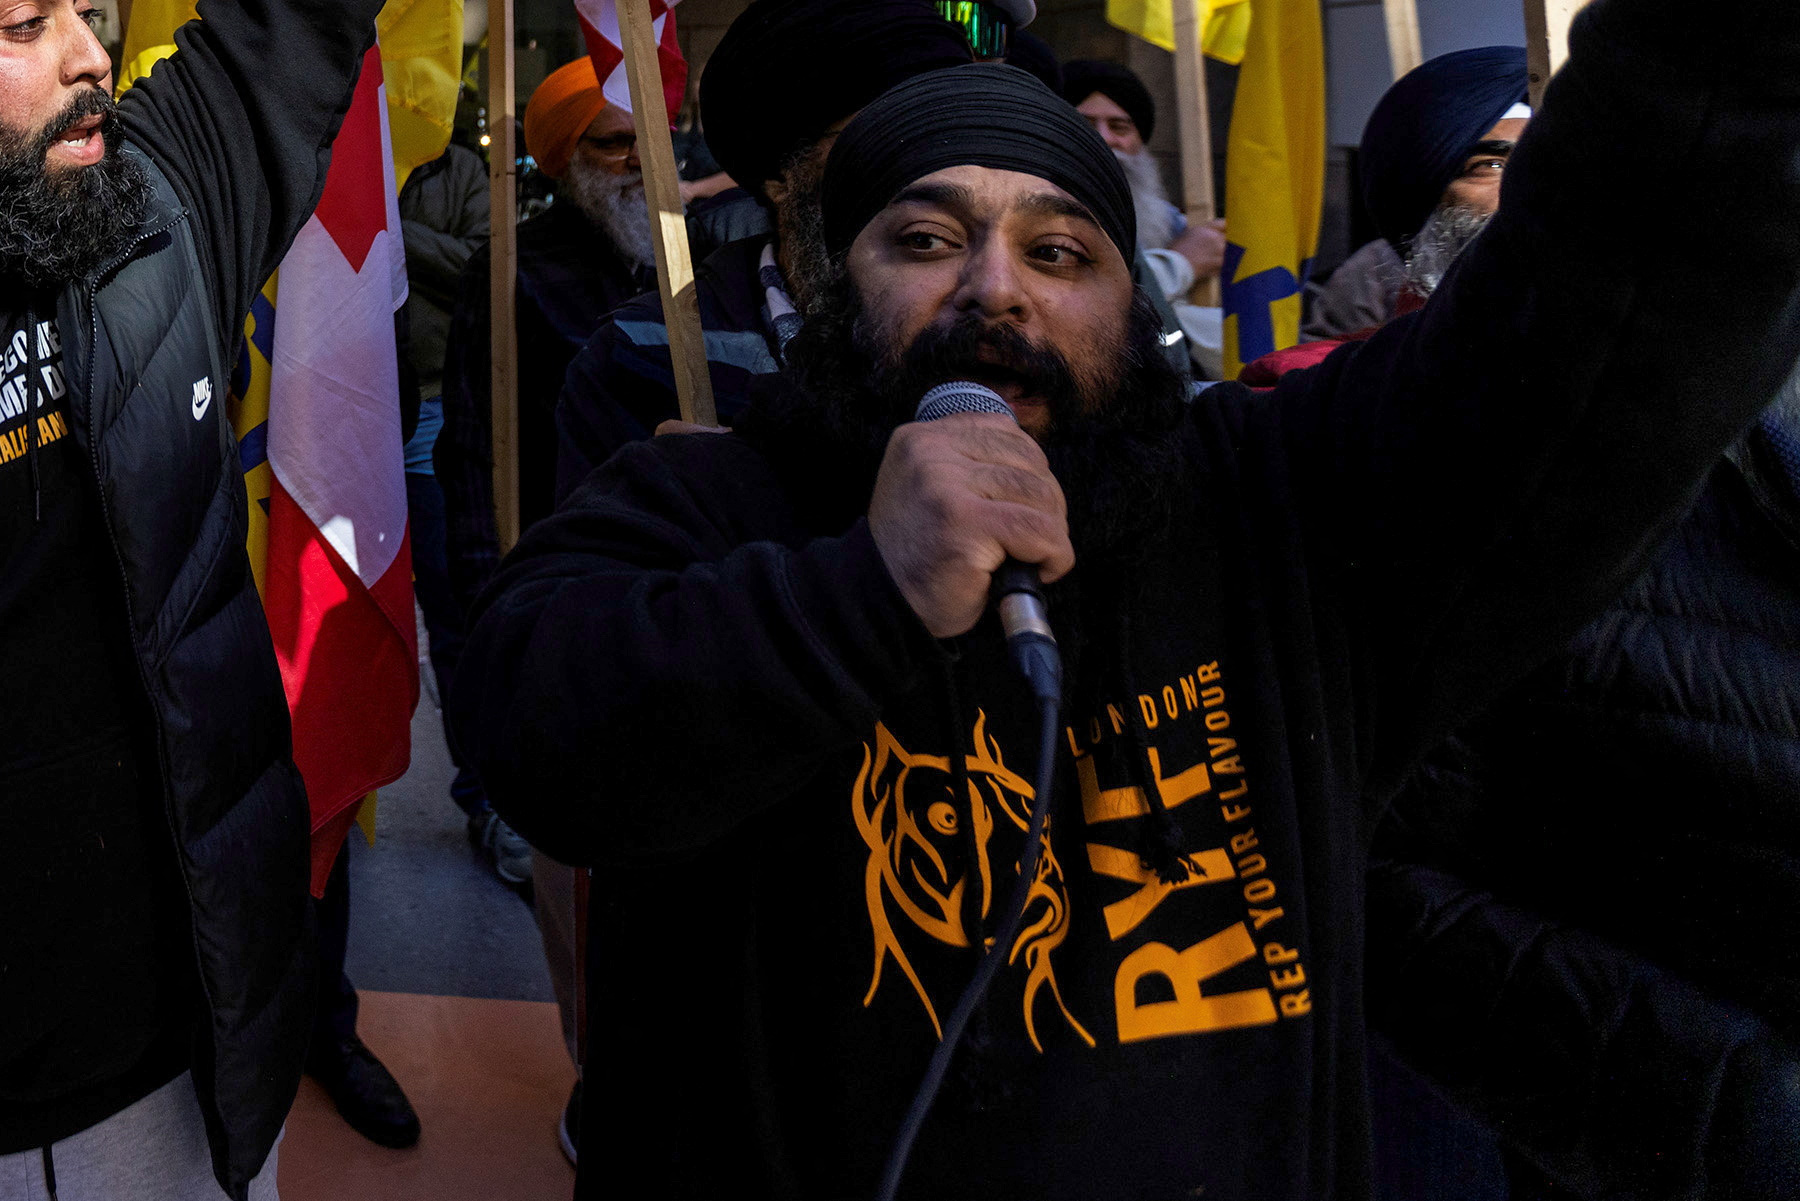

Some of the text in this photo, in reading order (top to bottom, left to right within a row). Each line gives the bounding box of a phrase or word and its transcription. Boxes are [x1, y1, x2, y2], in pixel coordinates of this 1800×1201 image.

[40, 360, 67, 400] D
[1196, 659, 1313, 1019] REP YOUR FLAVOUR
